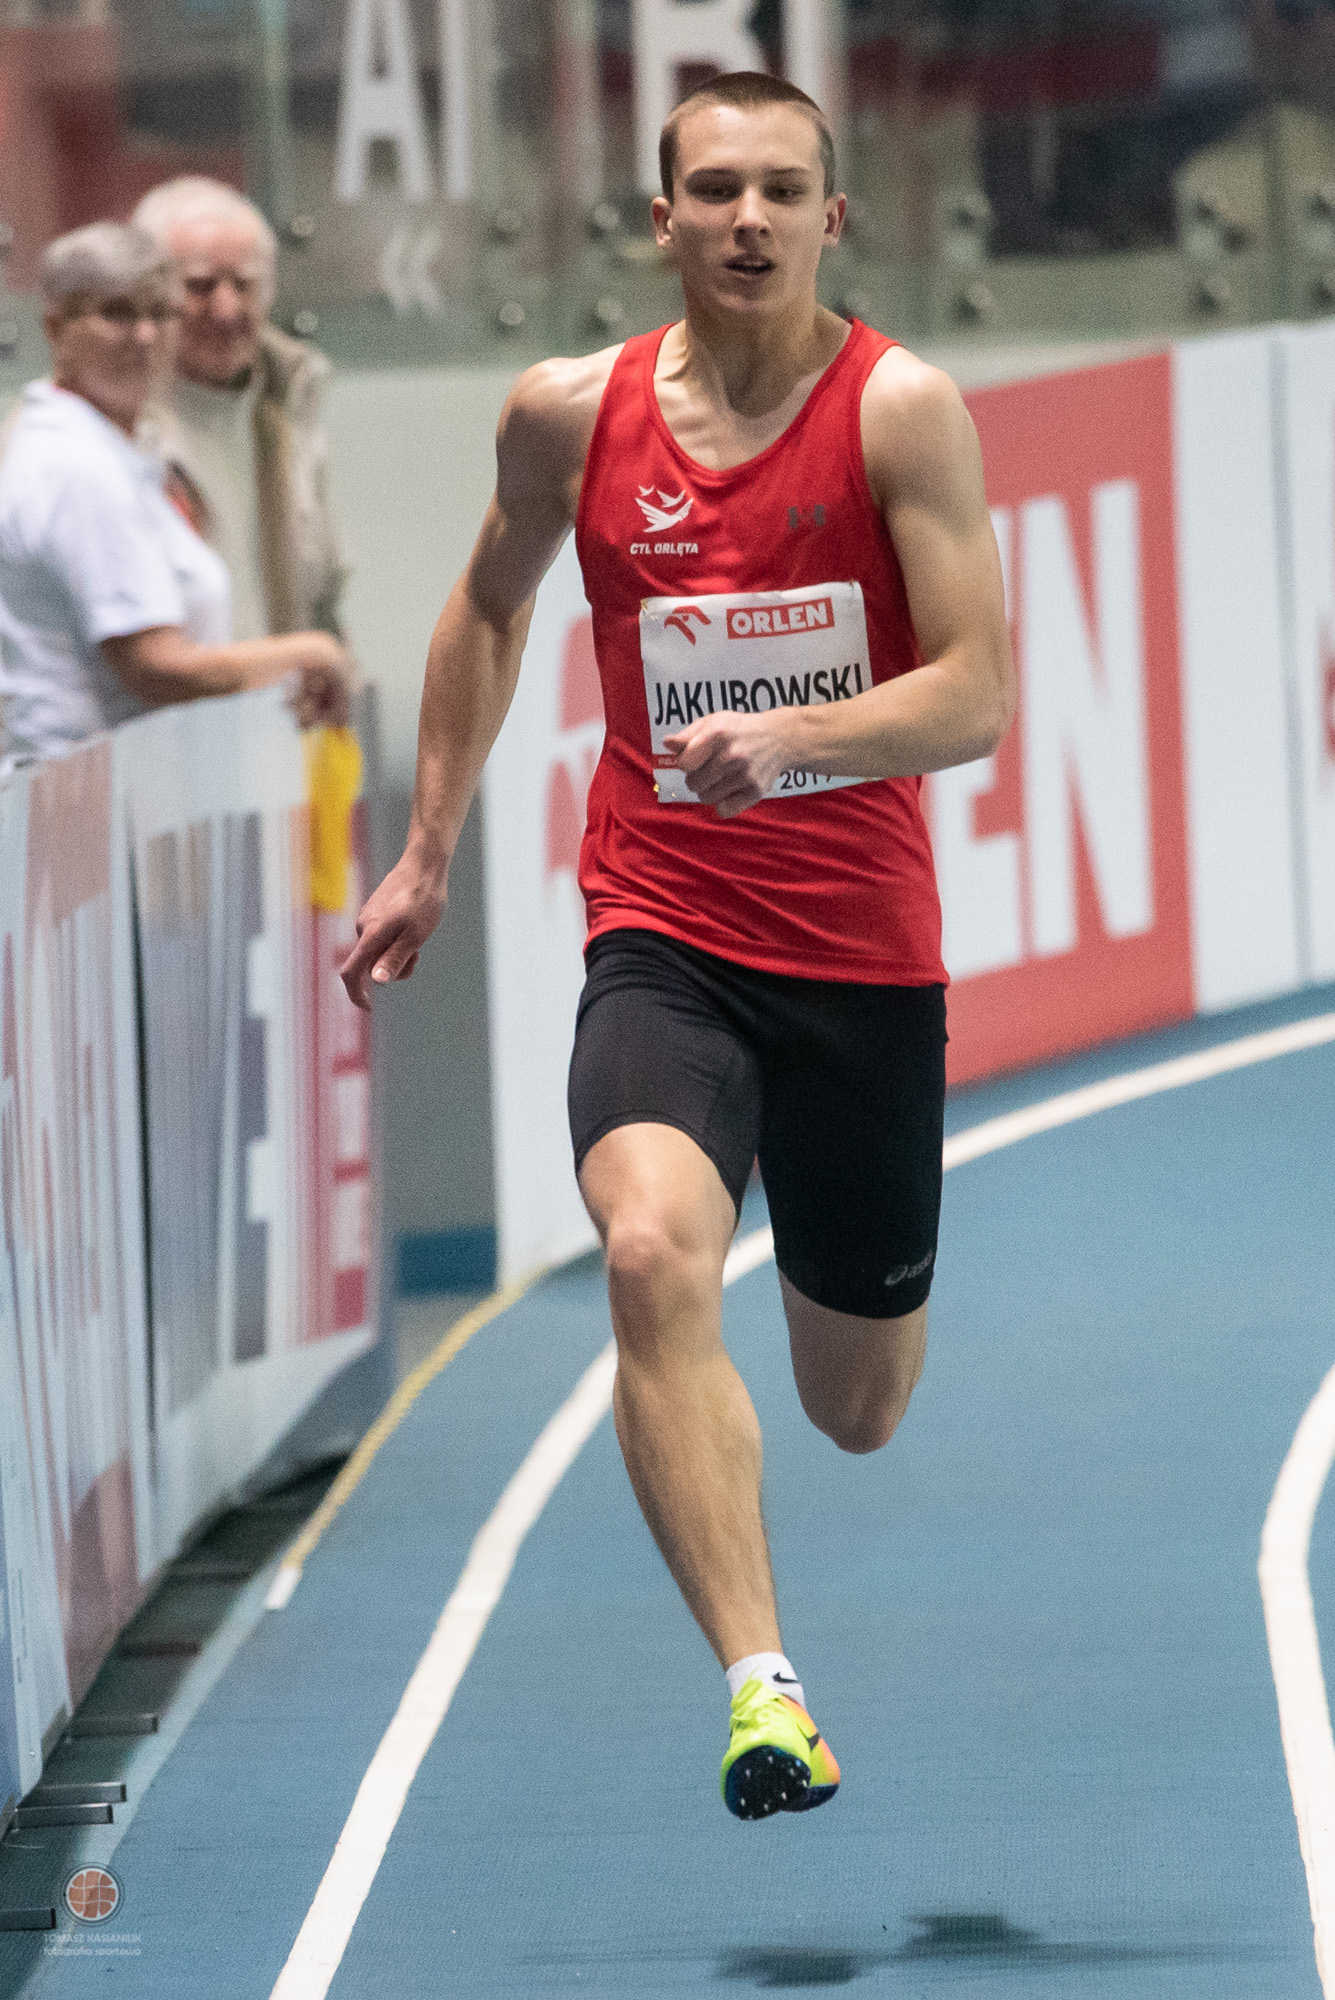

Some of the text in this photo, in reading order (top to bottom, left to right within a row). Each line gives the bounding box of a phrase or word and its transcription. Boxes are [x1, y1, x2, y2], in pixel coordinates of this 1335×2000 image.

[629, 542, 699, 557] CTL ORLĘTA
[731, 604, 829, 636] ORLEN
[654, 662, 864, 727] JAKUBOWSKI
